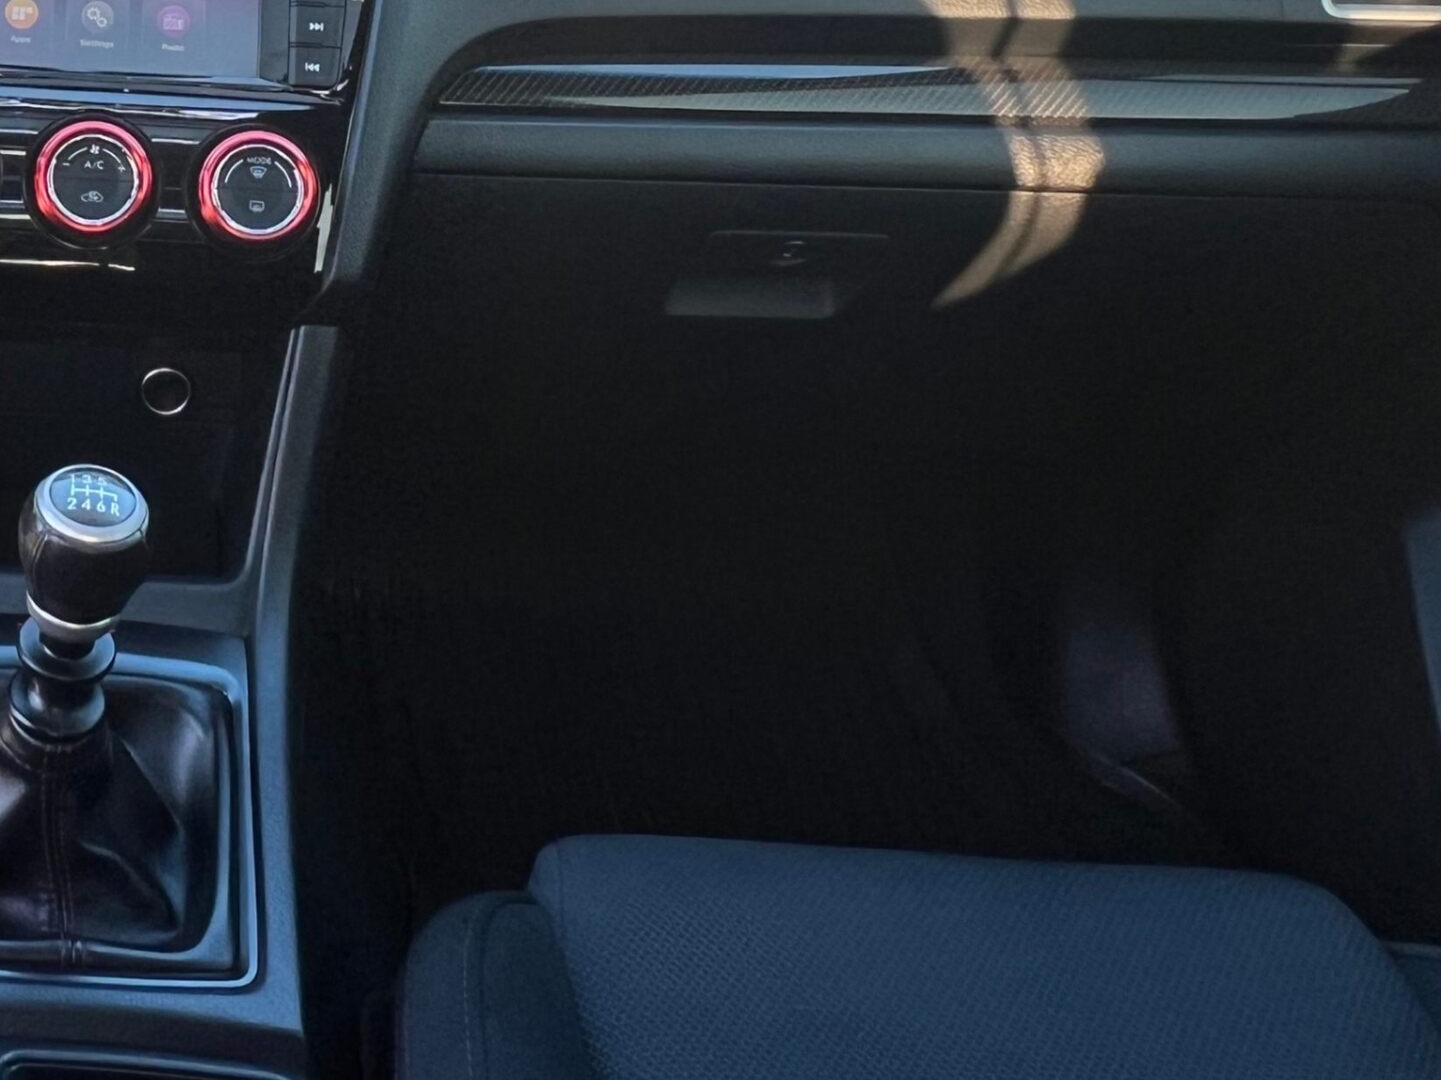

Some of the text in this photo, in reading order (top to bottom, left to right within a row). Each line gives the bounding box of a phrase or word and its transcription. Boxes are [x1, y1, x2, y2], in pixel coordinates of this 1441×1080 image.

[84, 160, 105, 170] A/C
[82, 475, 92, 484] 3
[67, 497, 120, 516] 2 4 6 R
